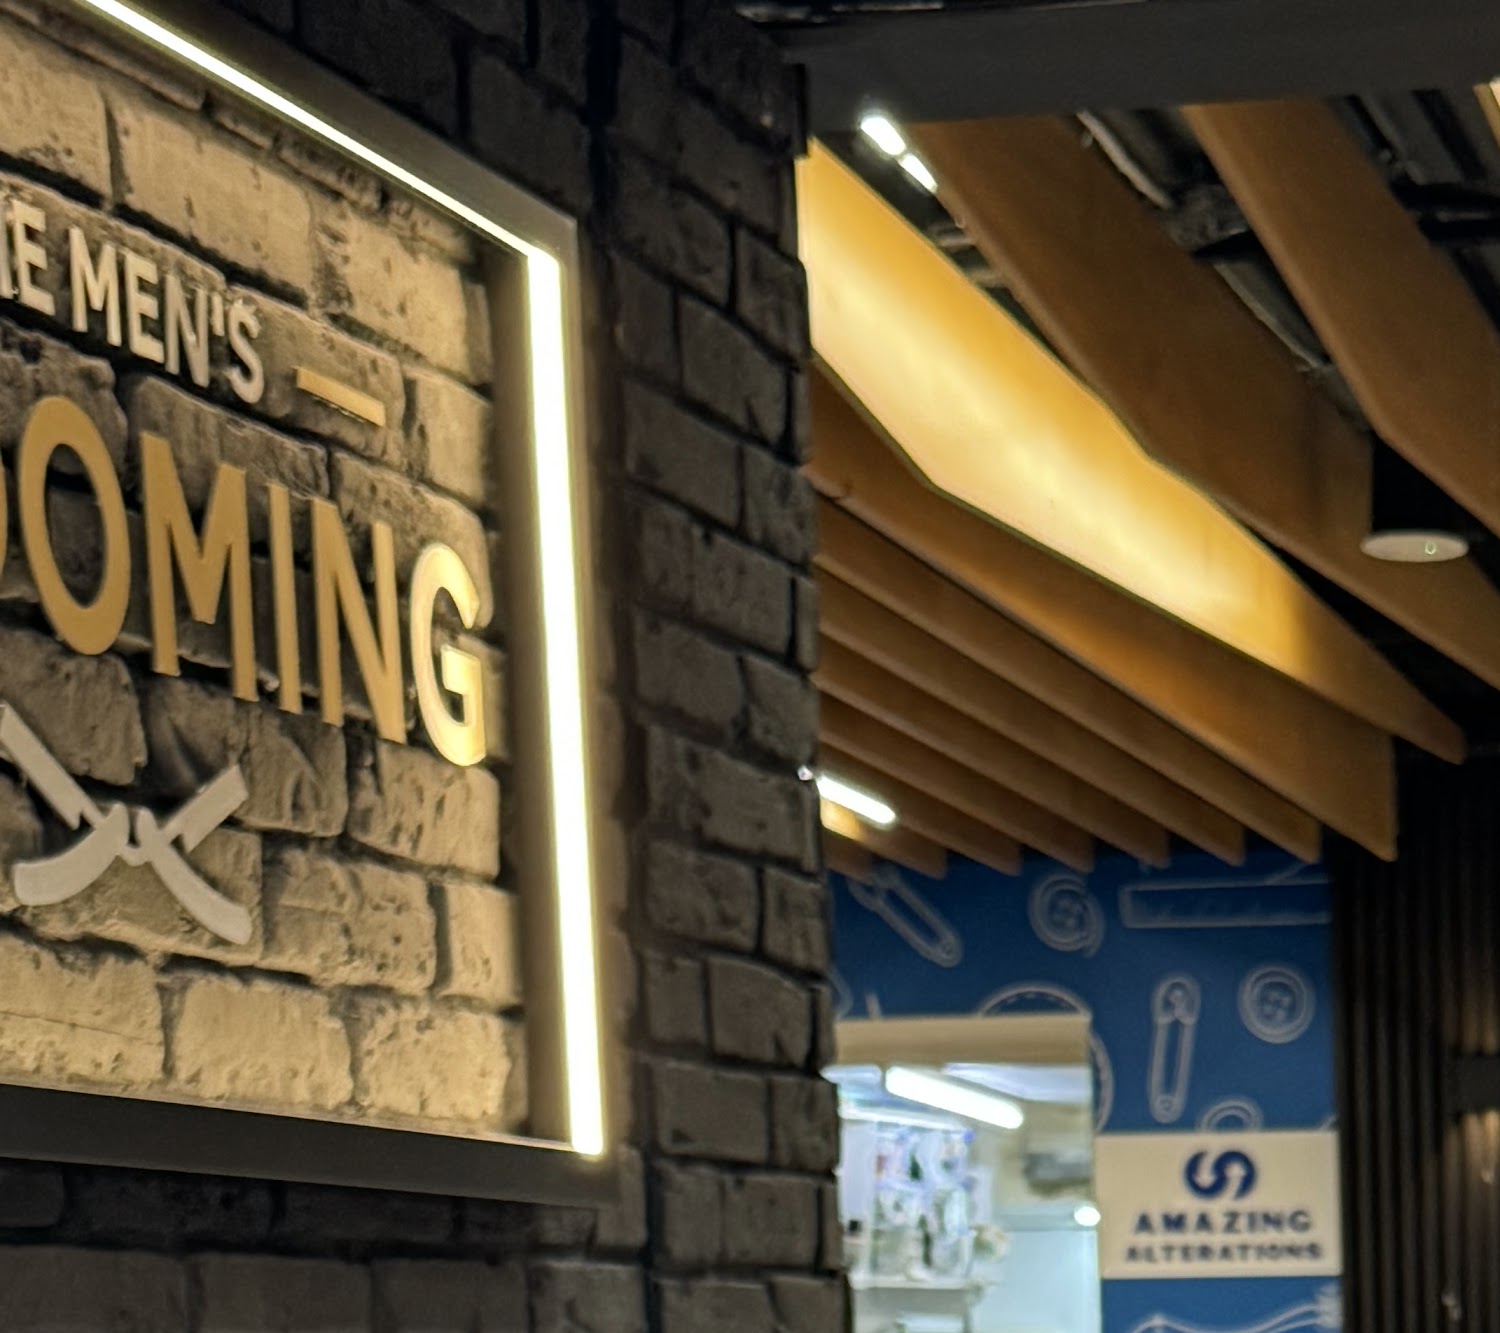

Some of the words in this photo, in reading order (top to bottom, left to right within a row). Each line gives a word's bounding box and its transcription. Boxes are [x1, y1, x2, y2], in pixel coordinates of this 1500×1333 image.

[69, 226, 264, 404] MEN'S
[0, 395, 487, 767] OMING
[1125, 1243, 1323, 1262] ALTERATIONS
[1134, 1210, 1312, 1235] AMAZING
